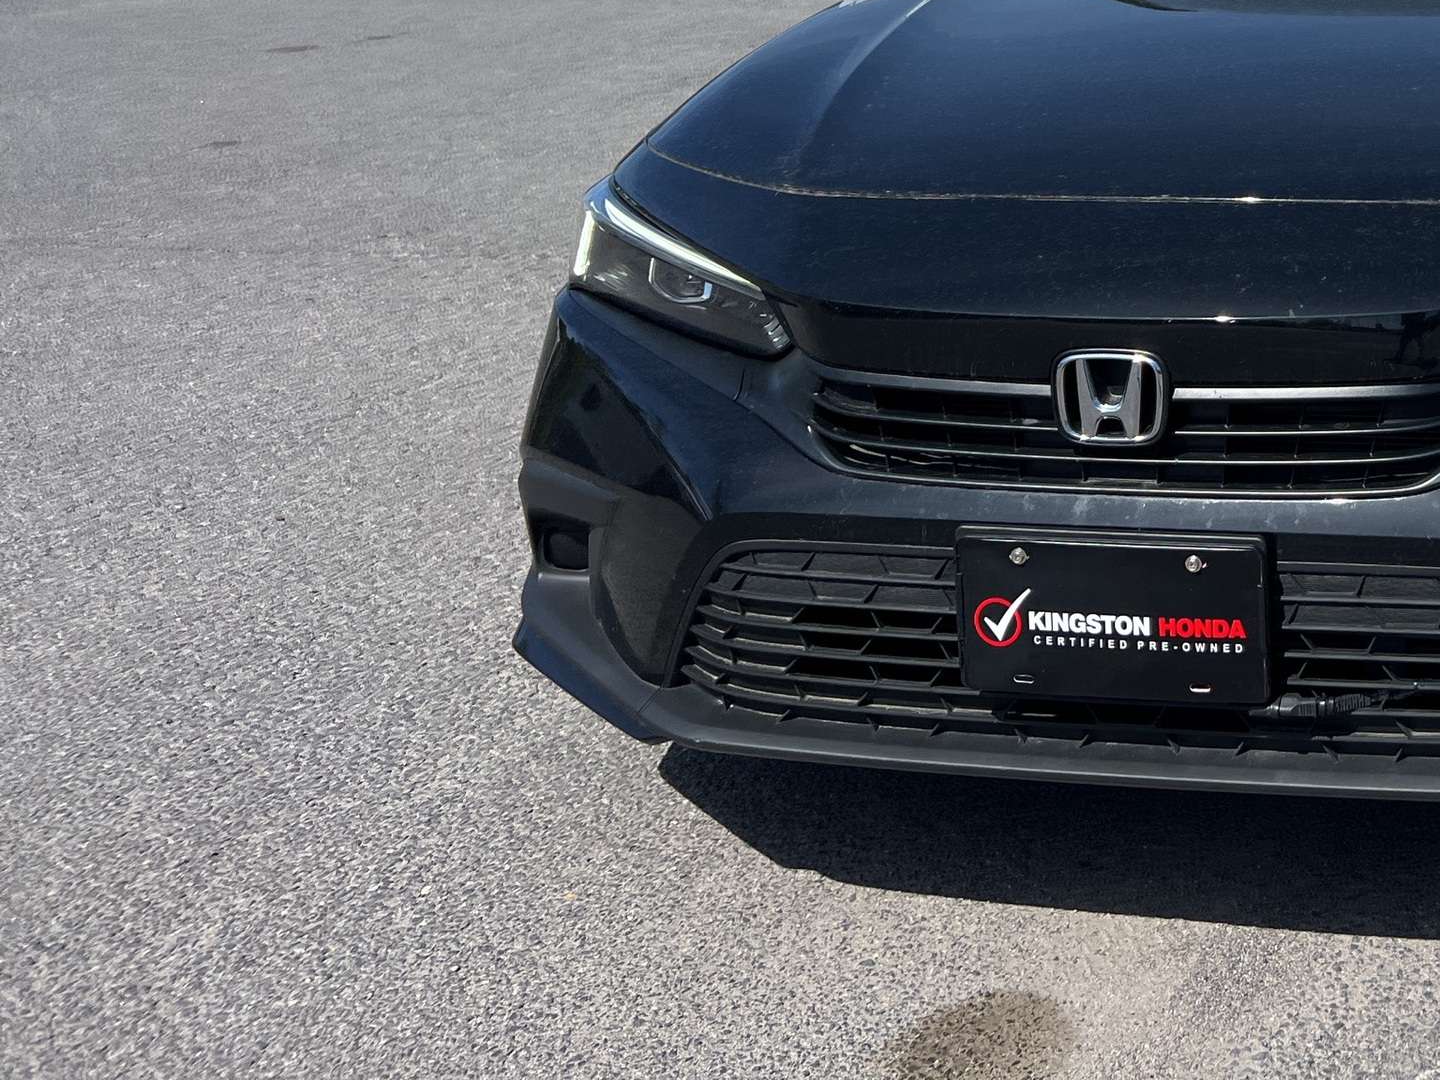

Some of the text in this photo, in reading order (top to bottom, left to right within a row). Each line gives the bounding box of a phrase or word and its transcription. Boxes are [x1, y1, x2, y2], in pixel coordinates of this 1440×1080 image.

[1028, 611, 1246, 639] KINGSTON HONDA
[1033, 635, 1244, 654] CERTIFIED PRE-OWNED
